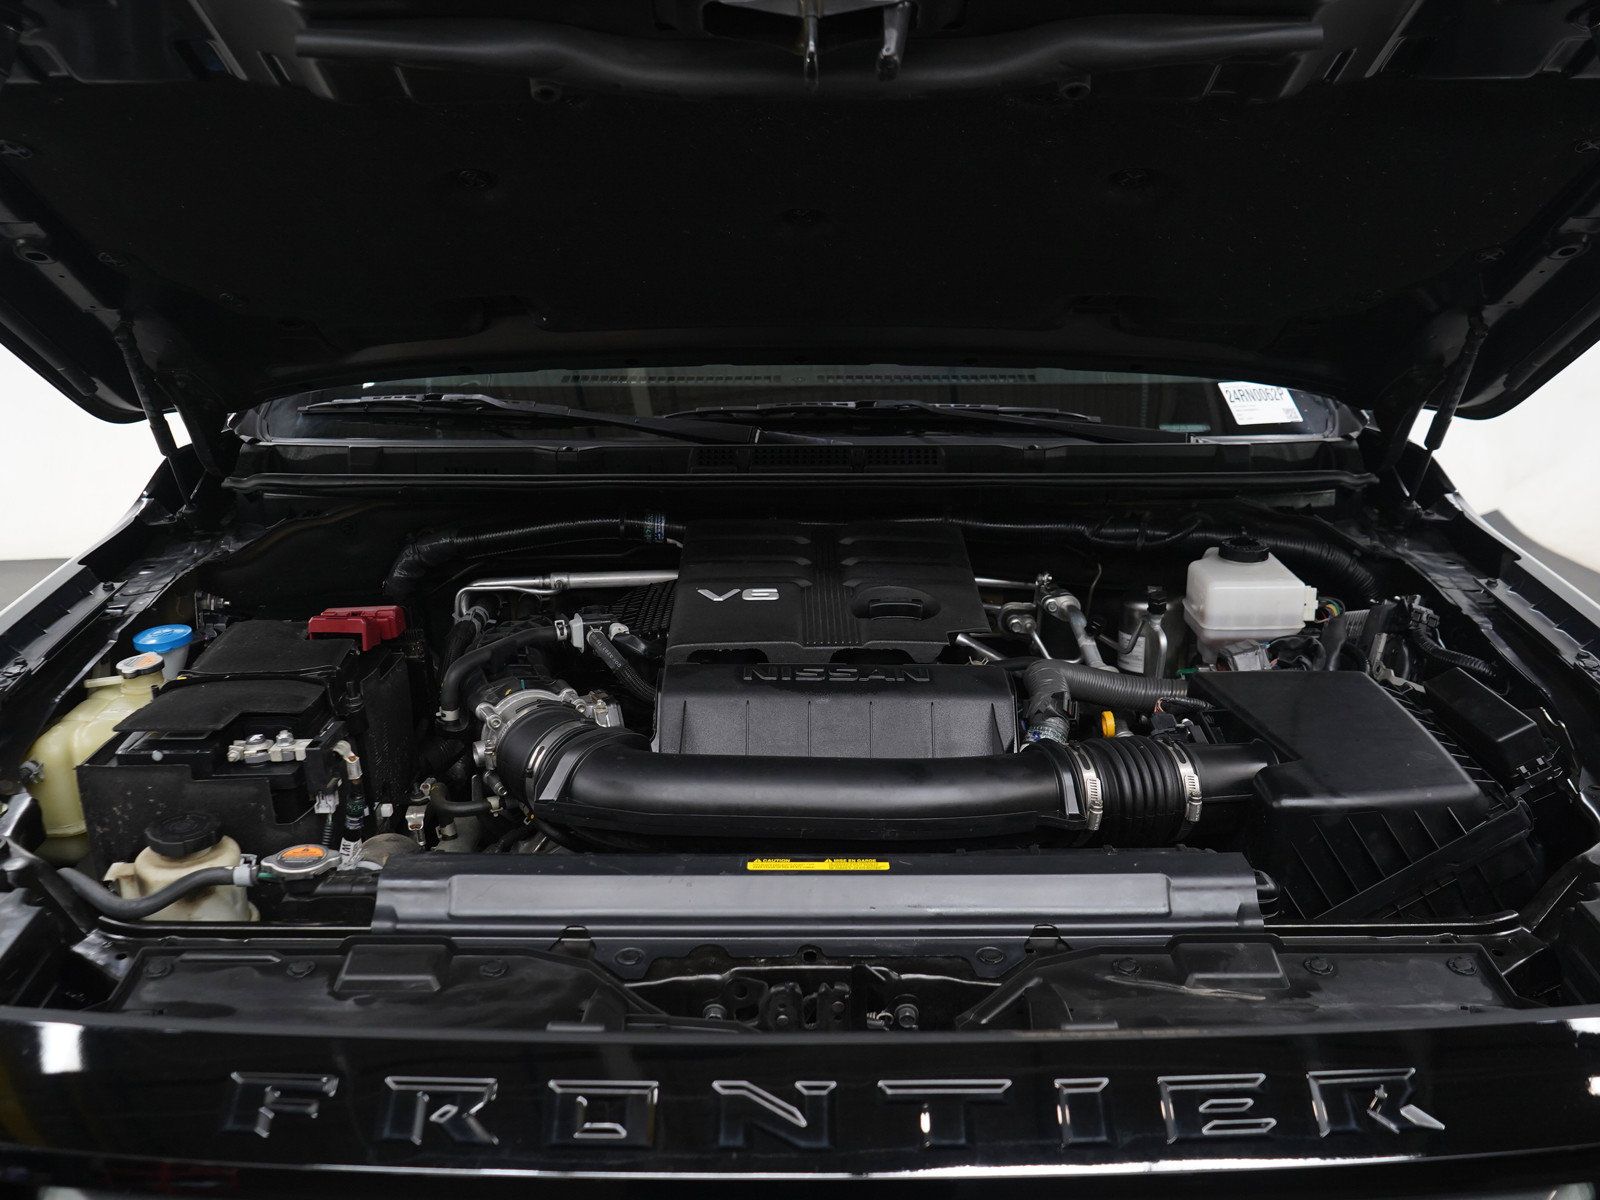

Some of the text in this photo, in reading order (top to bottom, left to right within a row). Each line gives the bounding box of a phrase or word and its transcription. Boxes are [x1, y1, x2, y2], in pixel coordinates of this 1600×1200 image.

[697, 587, 780, 602] V6
[743, 664, 931, 682] NISSAN
[221, 1067, 1446, 1149] FRONTIER
